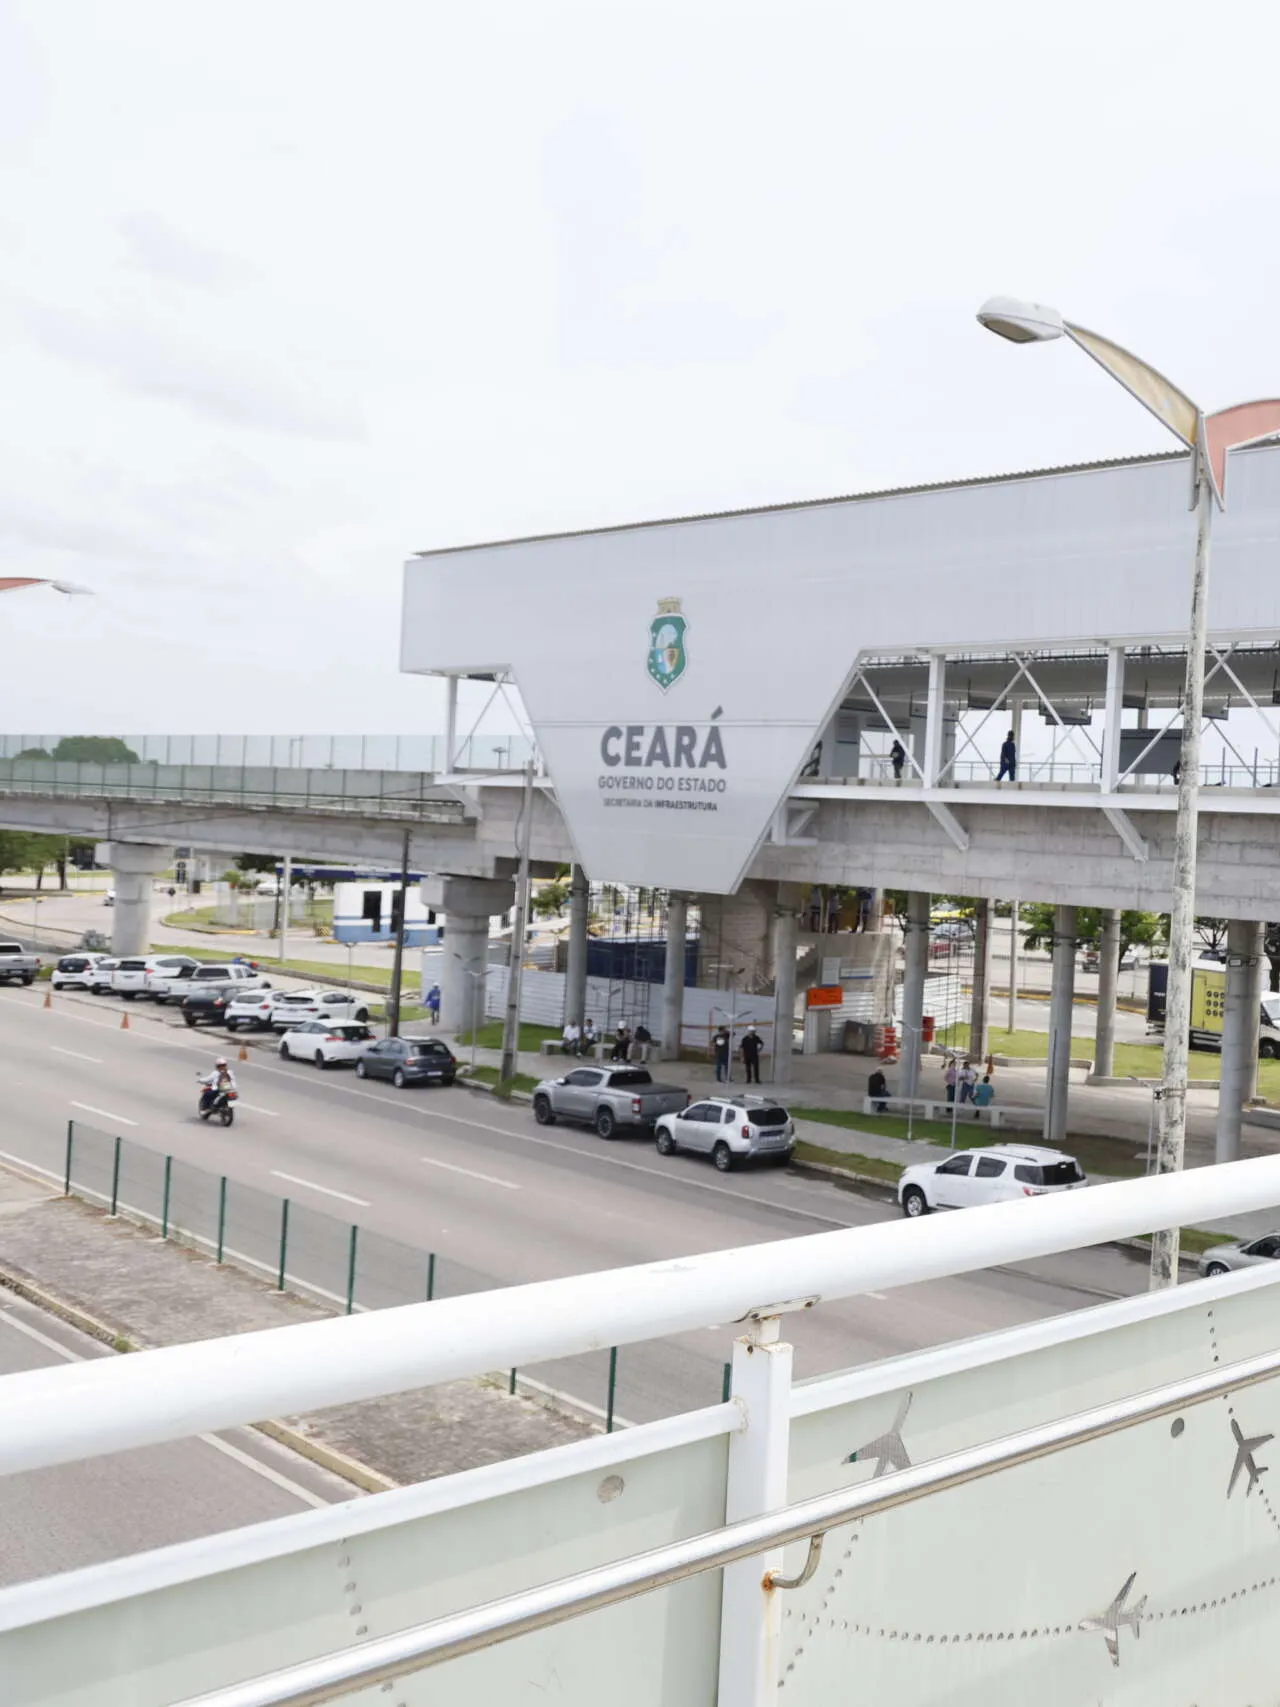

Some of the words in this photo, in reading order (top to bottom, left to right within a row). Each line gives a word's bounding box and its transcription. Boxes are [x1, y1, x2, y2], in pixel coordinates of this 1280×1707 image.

[600, 705, 727, 769] CEARÁ
[598, 775, 654, 790] GOVERNO
[657, 777, 675, 791] DO
[678, 777, 727, 793] ESTADO
[603, 799, 642, 808] SECRETARIA
[643, 799, 653, 808] DA
[654, 800, 717, 811] INFRAESTRUTURA
